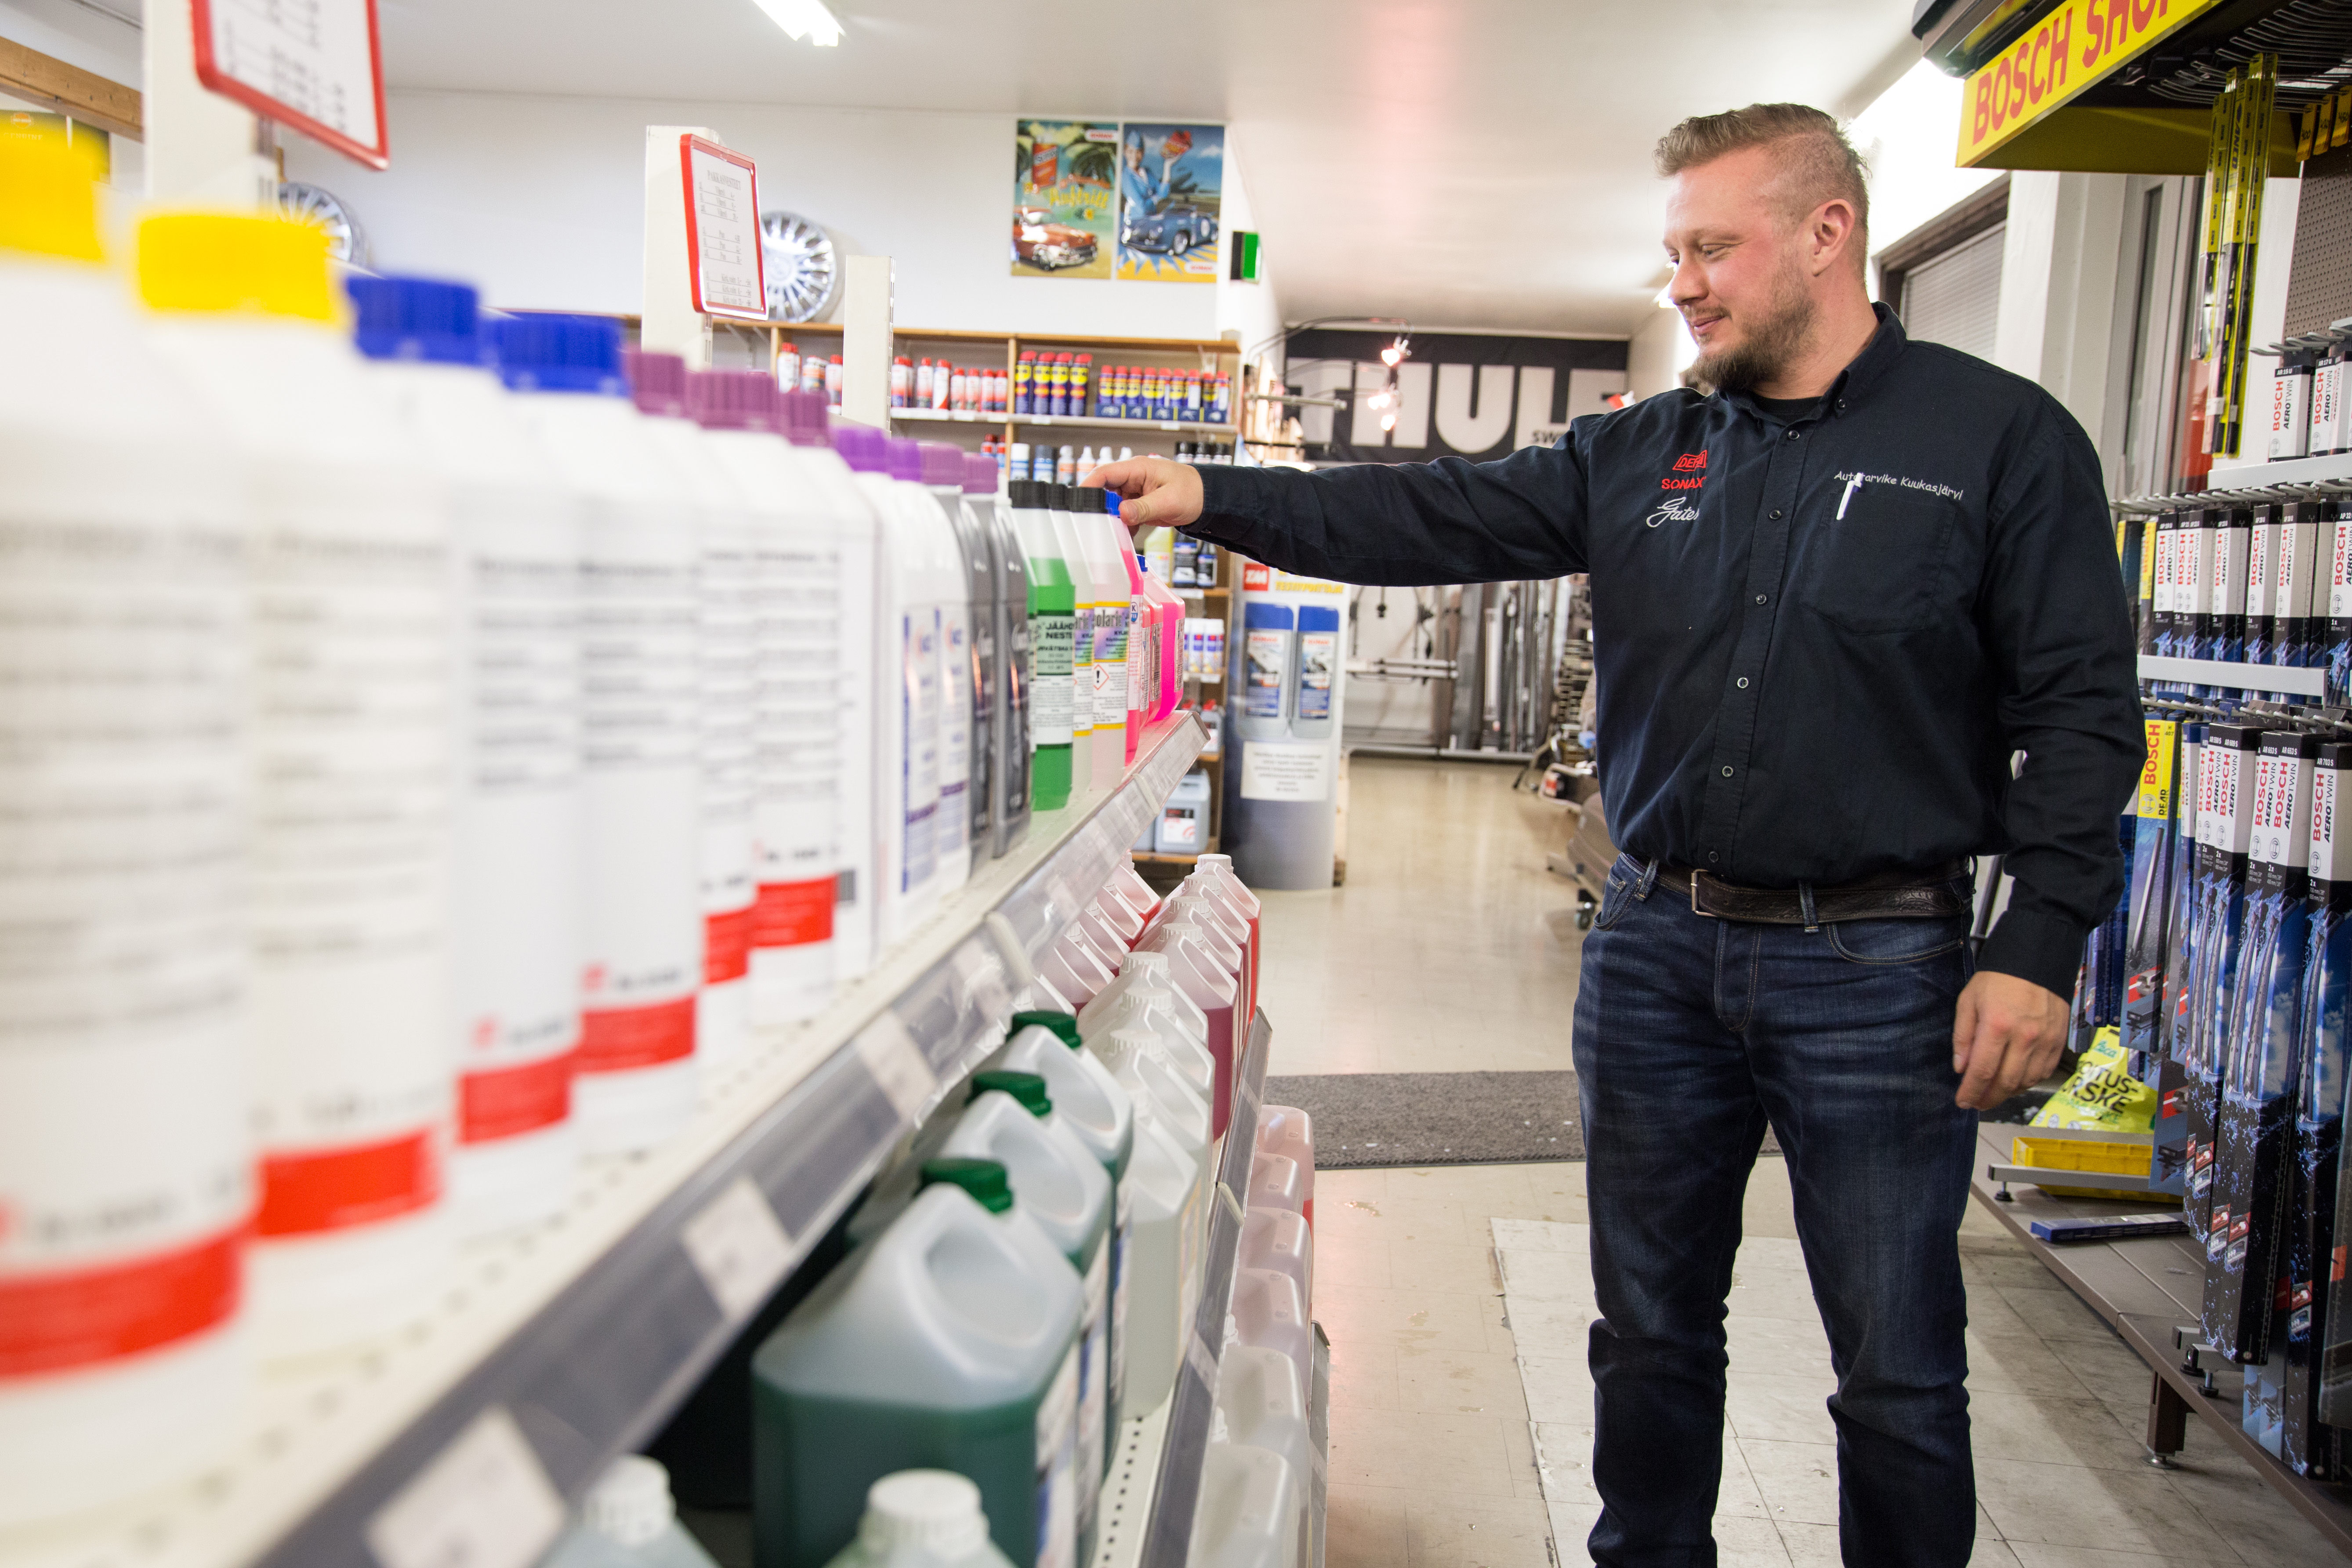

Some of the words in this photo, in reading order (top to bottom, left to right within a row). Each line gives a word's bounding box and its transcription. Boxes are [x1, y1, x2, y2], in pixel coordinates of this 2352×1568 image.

[1972, 6, 2073, 146] BOSCH
[2273, 381, 2283, 431] BOSCH
[2283, 380, 2293, 429] AEROTWIN
[2314, 372, 2324, 424] BOSCH
[2324, 370, 2332, 422] AEROTWIN
[1646, 496, 1700, 527] Gates
[1661, 477, 1704, 489] SONAX
[2251, 531, 2259, 585] BOSCH
[2279, 529, 2287, 586] BOSCH
[2334, 527, 2346, 585] BOSCH
[1093, 609, 1121, 627] olaric
[2144, 724, 2160, 785] BOSCH
[2206, 750, 2214, 811] BOSCH
[2220, 754, 2230, 816] BOSCH
[2229, 755, 2238, 818] AEROTWIN
[2255, 761, 2269, 826] BOSCH
[2265, 763, 2276, 828] AEROTWIN
[2273, 762, 2288, 828] BOSCH
[2284, 764, 2296, 829] AEROTWIN
[2313, 774, 2324, 841] BOSCH
[2324, 775, 2334, 843] AEROTWIN
[2268, 864, 2275, 873] 2x
